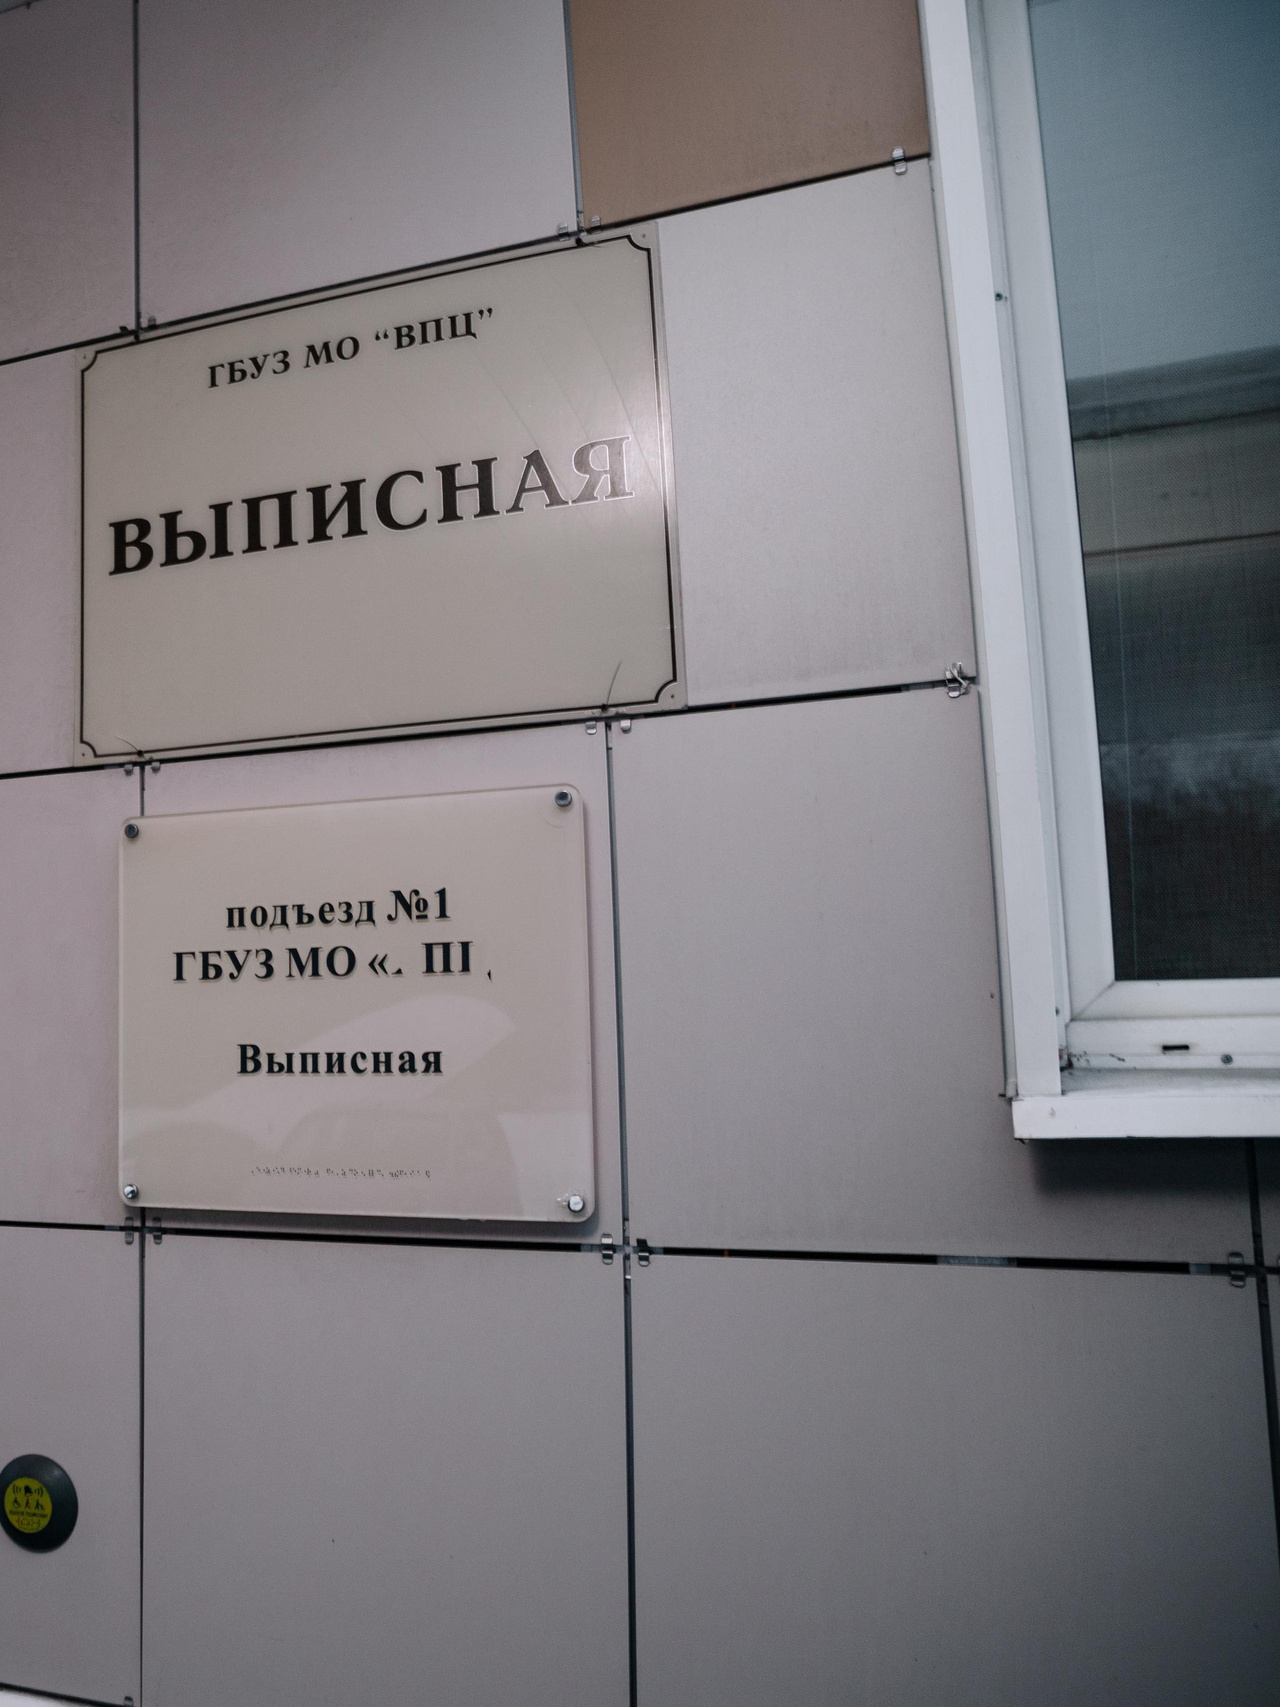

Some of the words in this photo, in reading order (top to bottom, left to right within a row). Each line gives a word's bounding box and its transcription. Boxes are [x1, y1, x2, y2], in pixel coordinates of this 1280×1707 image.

[207, 349, 291, 389] ГБУЗ
[303, 335, 360, 369] МО
[108, 434, 635, 577] ВЫПИСНАЯ
[225, 900, 376, 932] подъезд
[386, 886, 451, 923] №1
[172, 948, 275, 983] ГБУЗ
[285, 945, 357, 979] МО
[236, 1043, 444, 1076] Выписная
